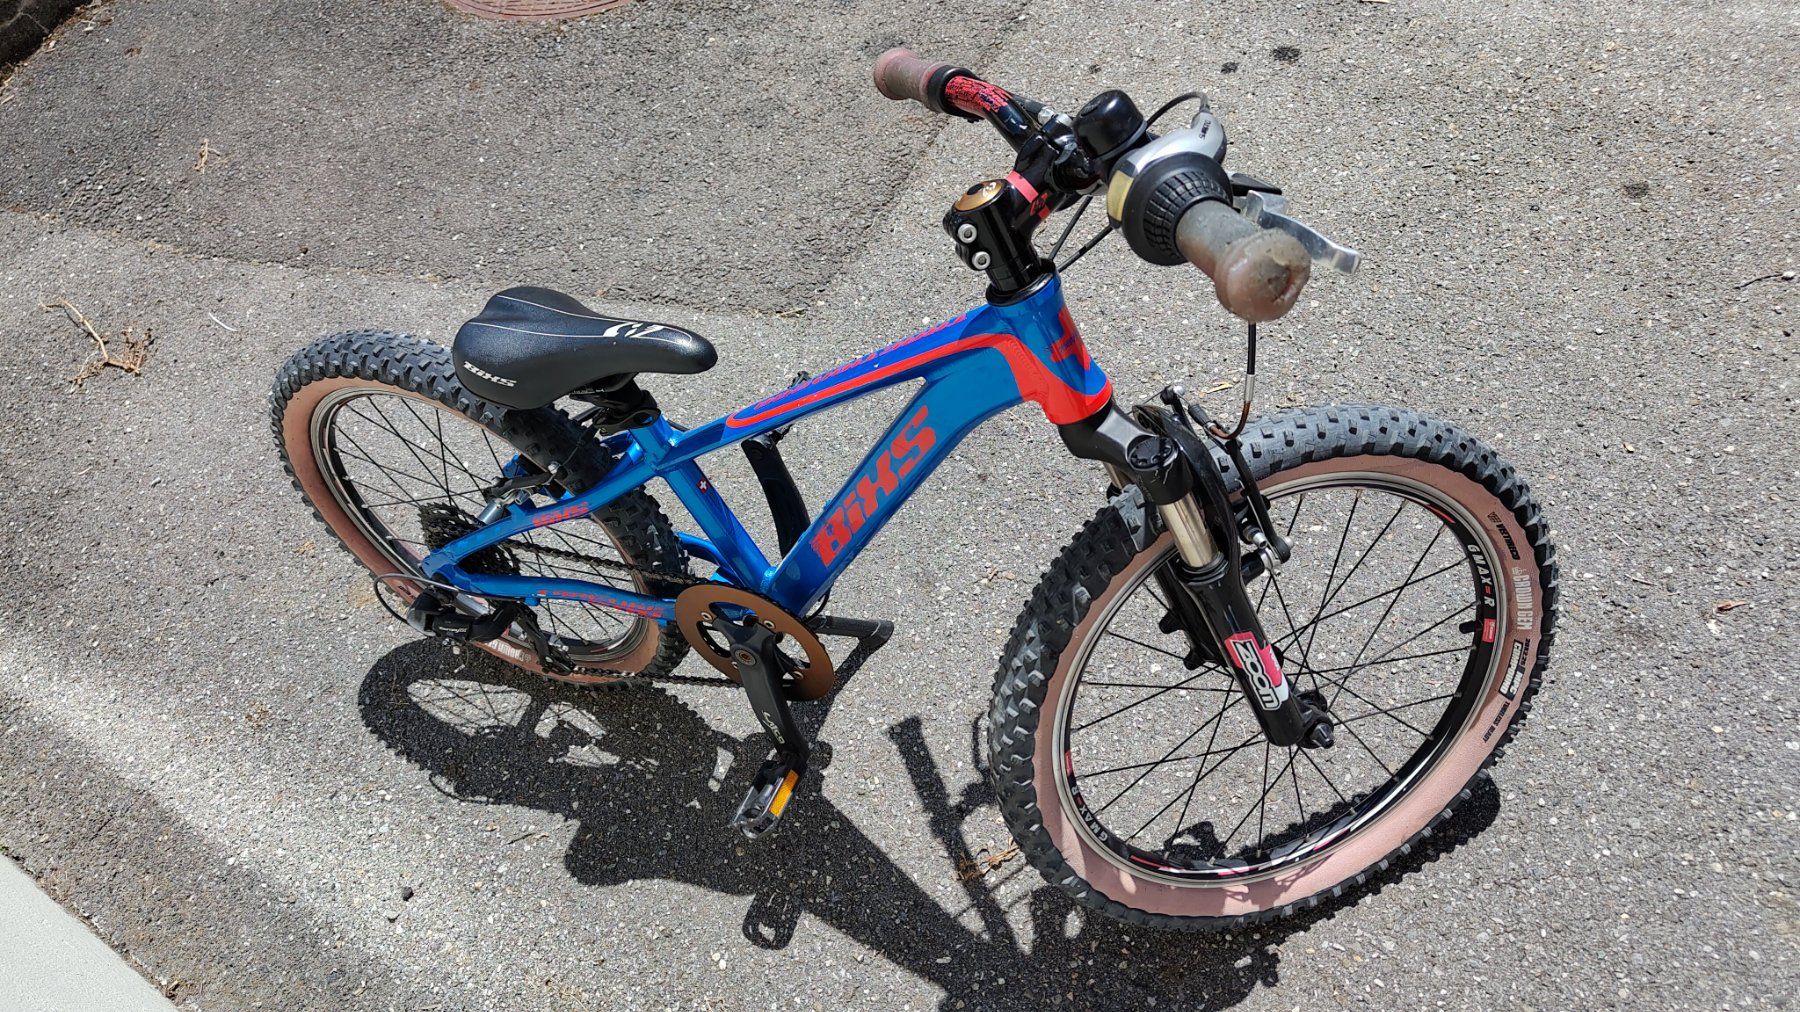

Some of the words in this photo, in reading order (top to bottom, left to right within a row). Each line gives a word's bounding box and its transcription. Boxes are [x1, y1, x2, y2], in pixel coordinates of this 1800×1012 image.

[1513, 574, 1533, 609] CROWN
[1517, 610, 1534, 630] GEM
[1232, 640, 1282, 710] ZOOM
[1500, 641, 1522, 695] COMPOUND
